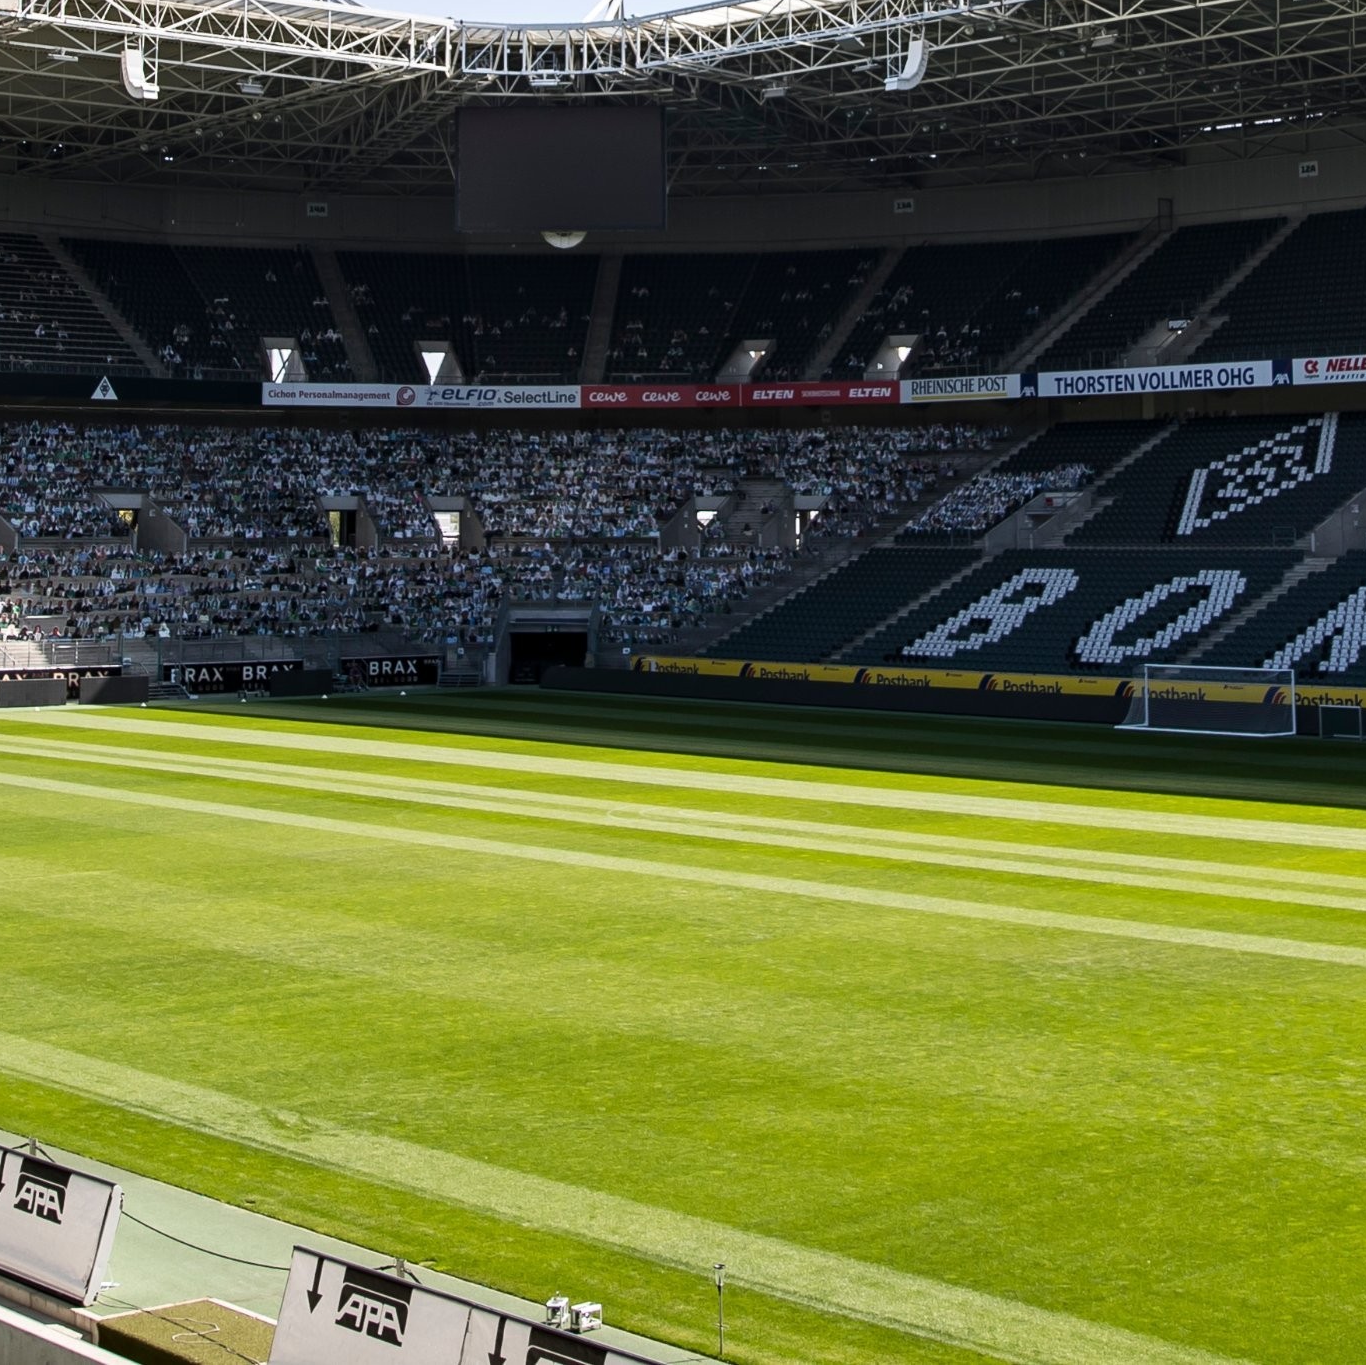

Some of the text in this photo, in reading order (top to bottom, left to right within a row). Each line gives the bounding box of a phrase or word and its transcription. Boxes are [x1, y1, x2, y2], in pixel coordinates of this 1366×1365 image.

[1301, 164, 1316, 174] 12A
[911, 376, 1008, 395] RHEINISCHE POST
[1054, 367, 1255, 394] THORSTEN VOLLMER OHG
[268, 389, 391, 402] Cichon Personalmanagement
[504, 391, 576, 403] SelectLine
[589, 391, 628, 403] cewe
[642, 391, 681, 403] cewe
[695, 390, 731, 402] cewe
[753, 389, 794, 400] ELTEN
[849, 387, 891, 398] ELTEN
[369, 659, 418, 676] BRAX
[760, 667, 810, 681] Postbank
[877, 673, 931, 687] Postbank
[1003, 679, 1063, 694] Postbank
